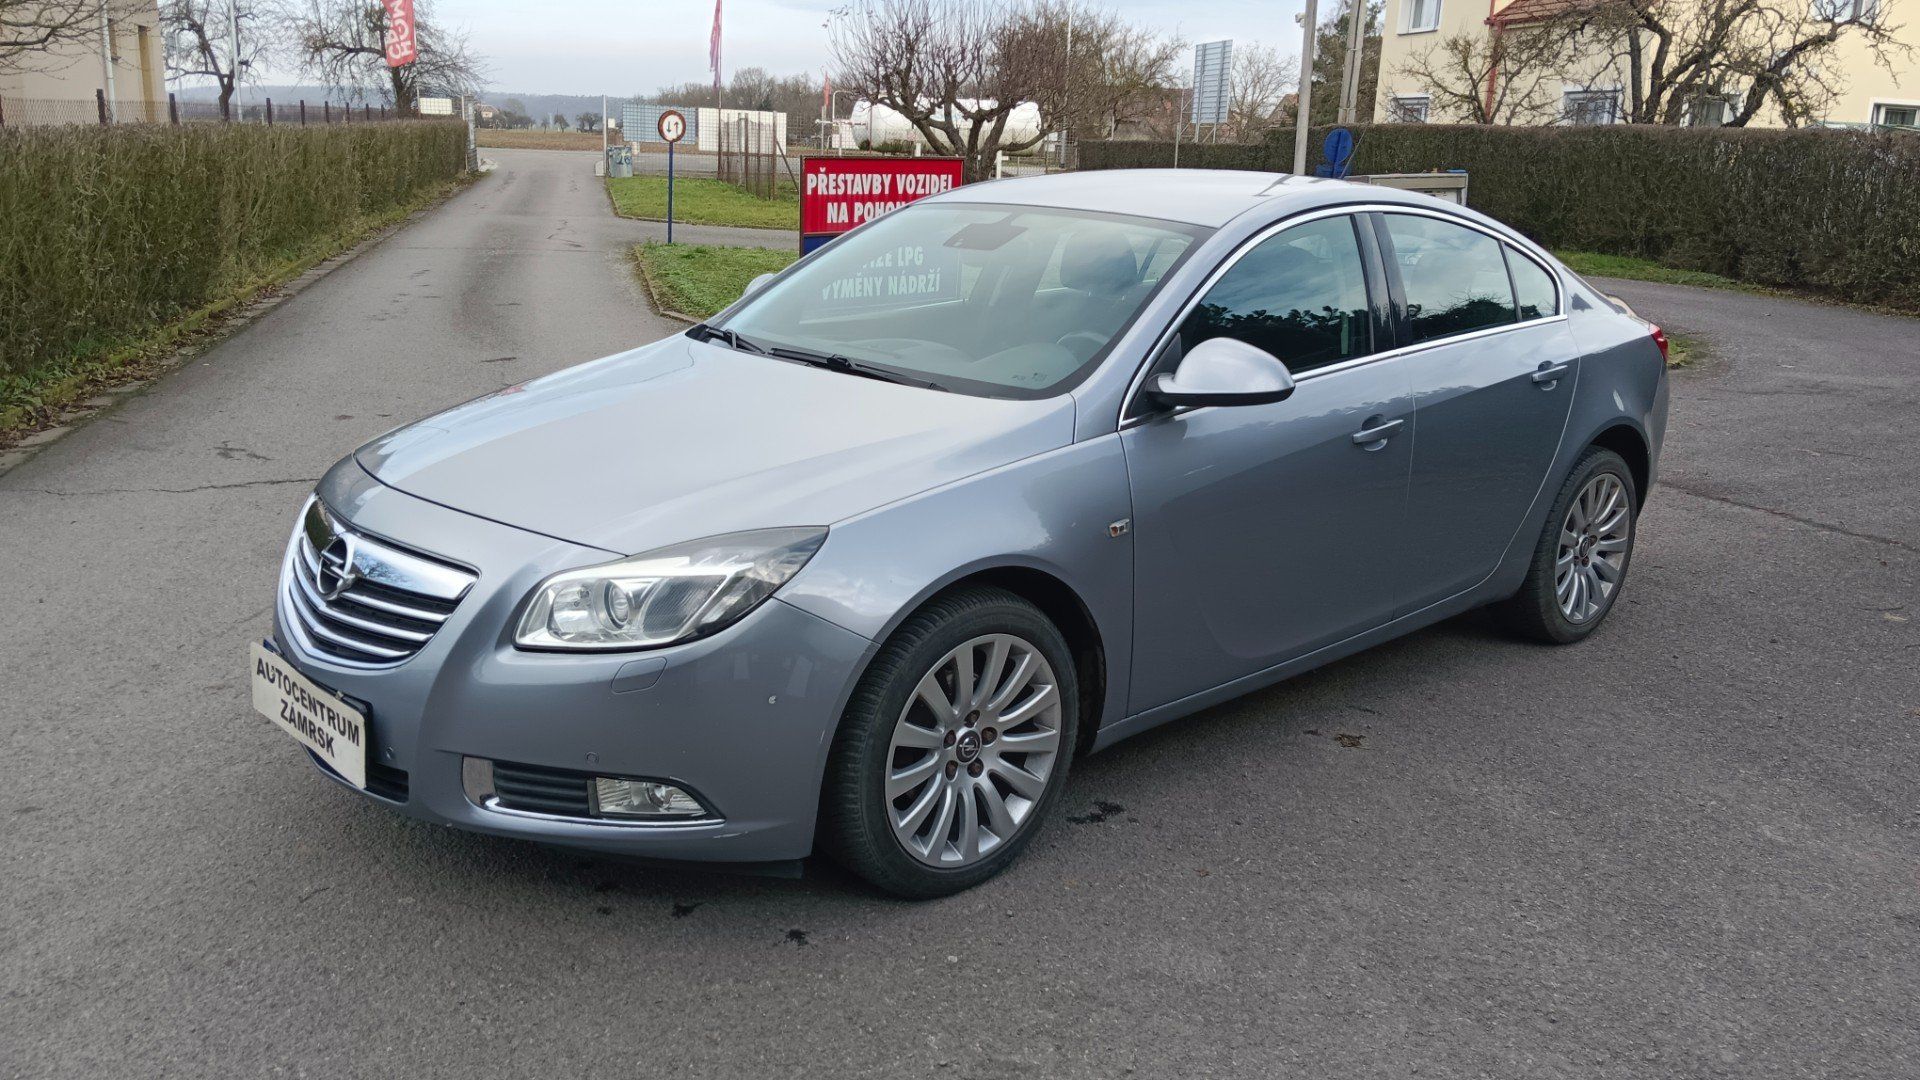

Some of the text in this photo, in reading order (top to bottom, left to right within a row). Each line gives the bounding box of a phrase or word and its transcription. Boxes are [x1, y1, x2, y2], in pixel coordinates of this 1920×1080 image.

[806, 167, 892, 195] PŘESTAVBY
[827, 202, 849, 224] NA
[897, 246, 924, 267] LPG
[888, 267, 941, 296] NÁDRŽÍ
[257, 658, 360, 747] AUTOCENTRUM
[280, 698, 335, 758] ZÁMRSK
